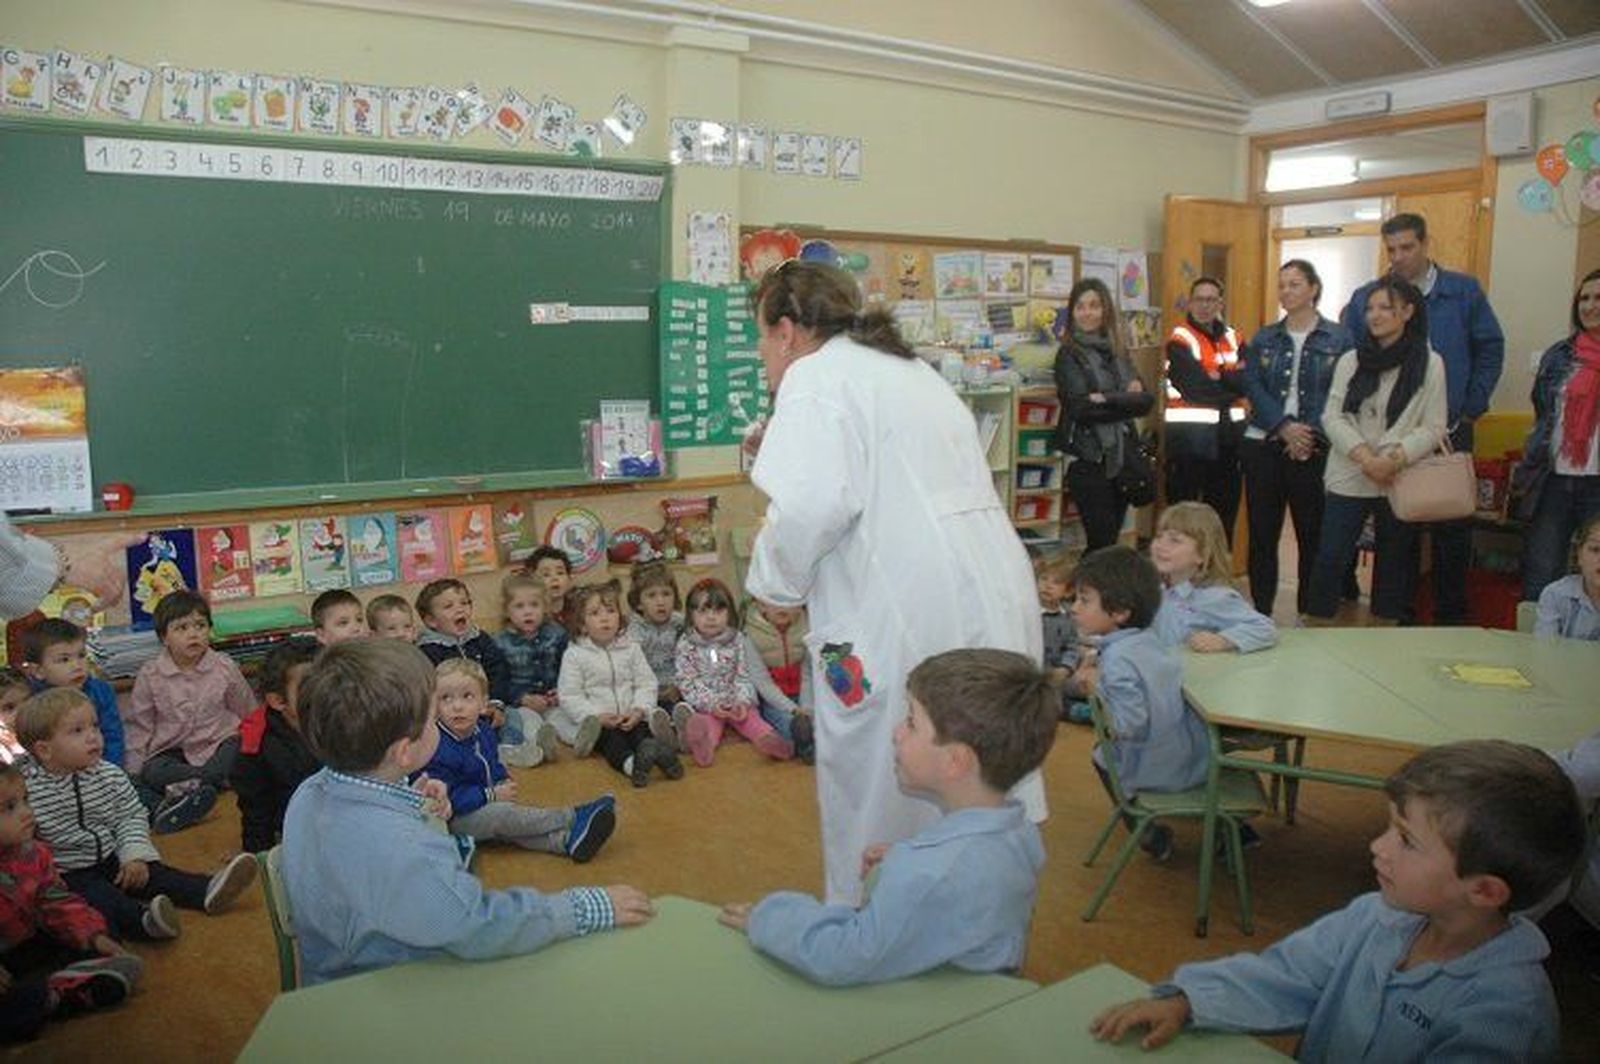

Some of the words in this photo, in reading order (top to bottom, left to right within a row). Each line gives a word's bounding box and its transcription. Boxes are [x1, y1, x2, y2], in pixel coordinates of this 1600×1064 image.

[4, 50, 20, 65] G
[56, 53, 72, 69] H
[95, 146, 108, 167] 1
[130, 148, 143, 169] 2
[165, 150, 177, 171] 3
[199, 152, 213, 171] 4
[229, 153, 241, 173] 5
[260, 155, 273, 175] 6
[293, 157, 303, 176] 7
[323, 159, 335, 178] 8
[352, 160, 362, 180] 9
[376, 163, 399, 183] 10
[406, 165, 431, 185] 11
[433, 167, 457, 187] 12
[459, 169, 484, 188] 13
[490, 170, 511, 189] 14
[512, 171, 533, 191] 15
[539, 173, 560, 192] 16
[565, 173, 585, 192] 17
[591, 175, 609, 194] 18
[615, 176, 634, 196] 19
[638, 180, 659, 197] 20
[443, 200, 470, 222] 19
[520, 209, 570, 230] MAYO
